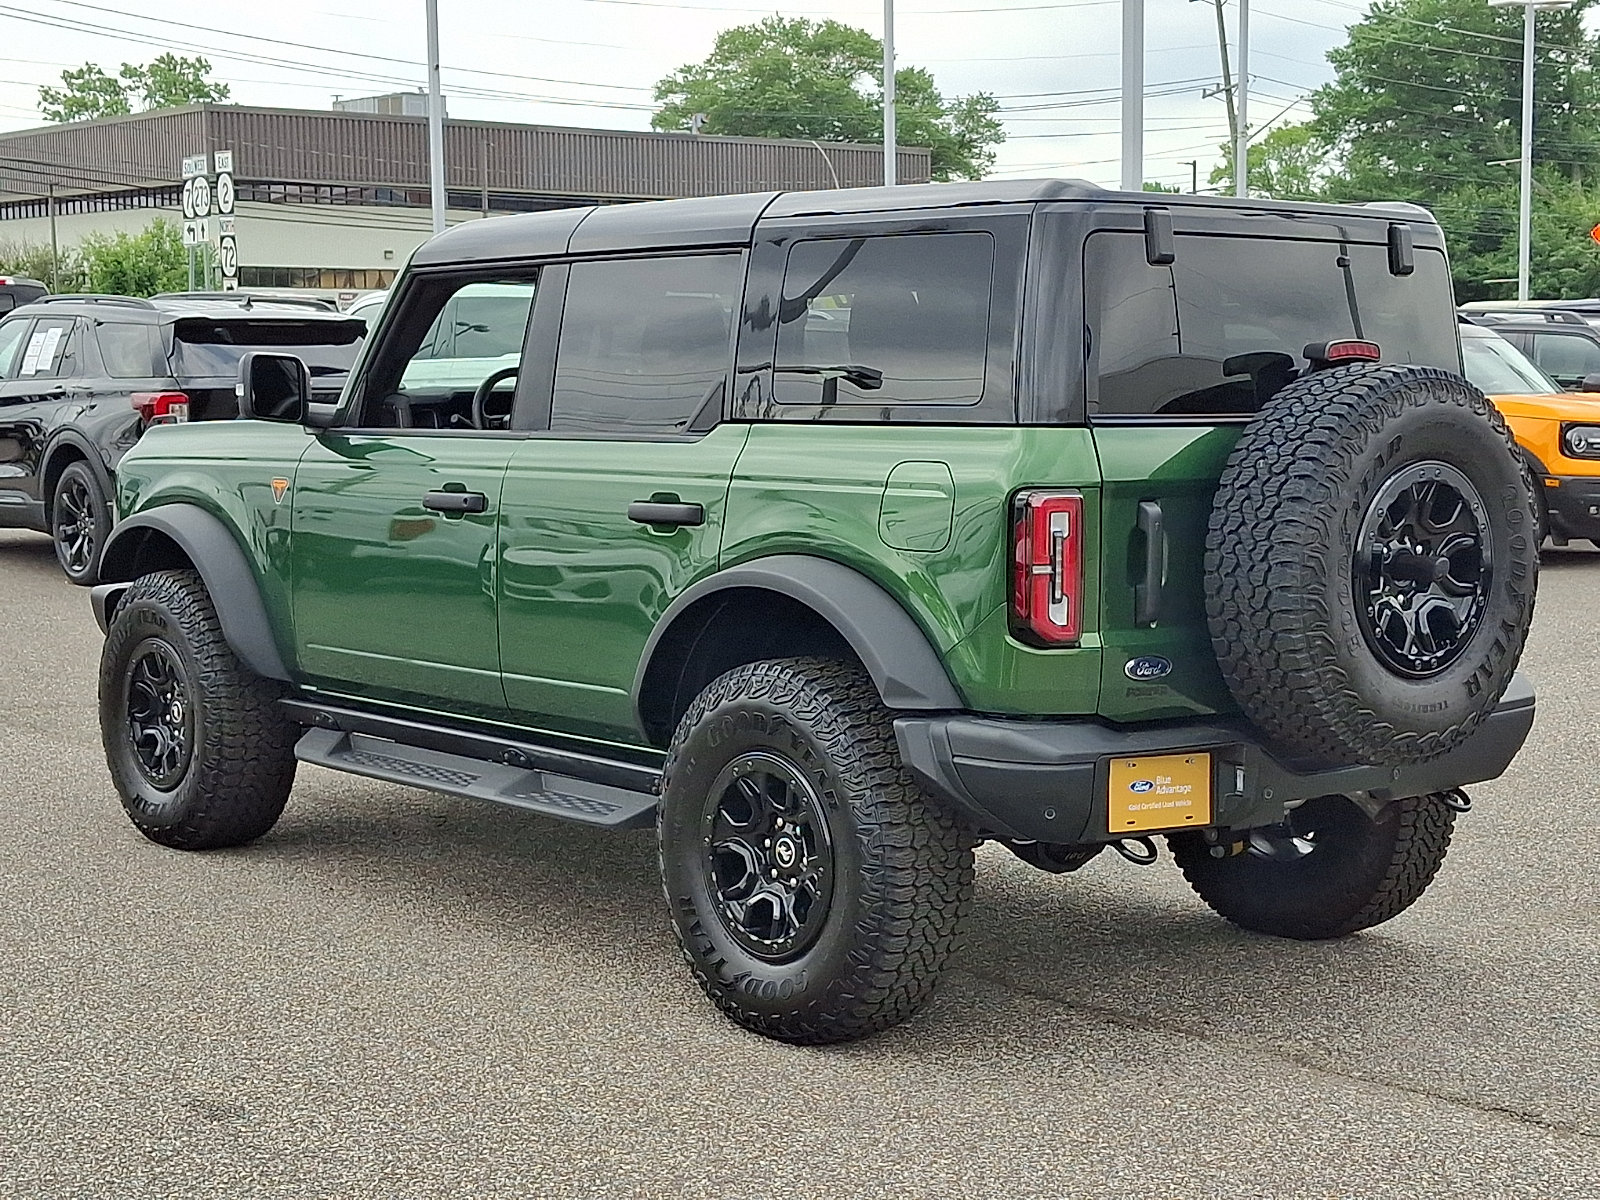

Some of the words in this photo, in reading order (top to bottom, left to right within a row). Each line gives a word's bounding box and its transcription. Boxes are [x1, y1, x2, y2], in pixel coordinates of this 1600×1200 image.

[184, 162, 194, 175] SOU
[194, 159, 205, 171] WEST
[217, 156, 229, 169] EAST
[185, 188, 191, 210] 7
[194, 185, 208, 208] 273
[223, 182, 230, 204] 2
[223, 245, 235, 268] 72
[1156, 775, 1172, 785] Blue
[1156, 784, 1192, 795] Advantage
[1128, 803, 1141, 811] Gold
[1141, 801, 1162, 810] Certified
[1162, 800, 1175, 808] Used
